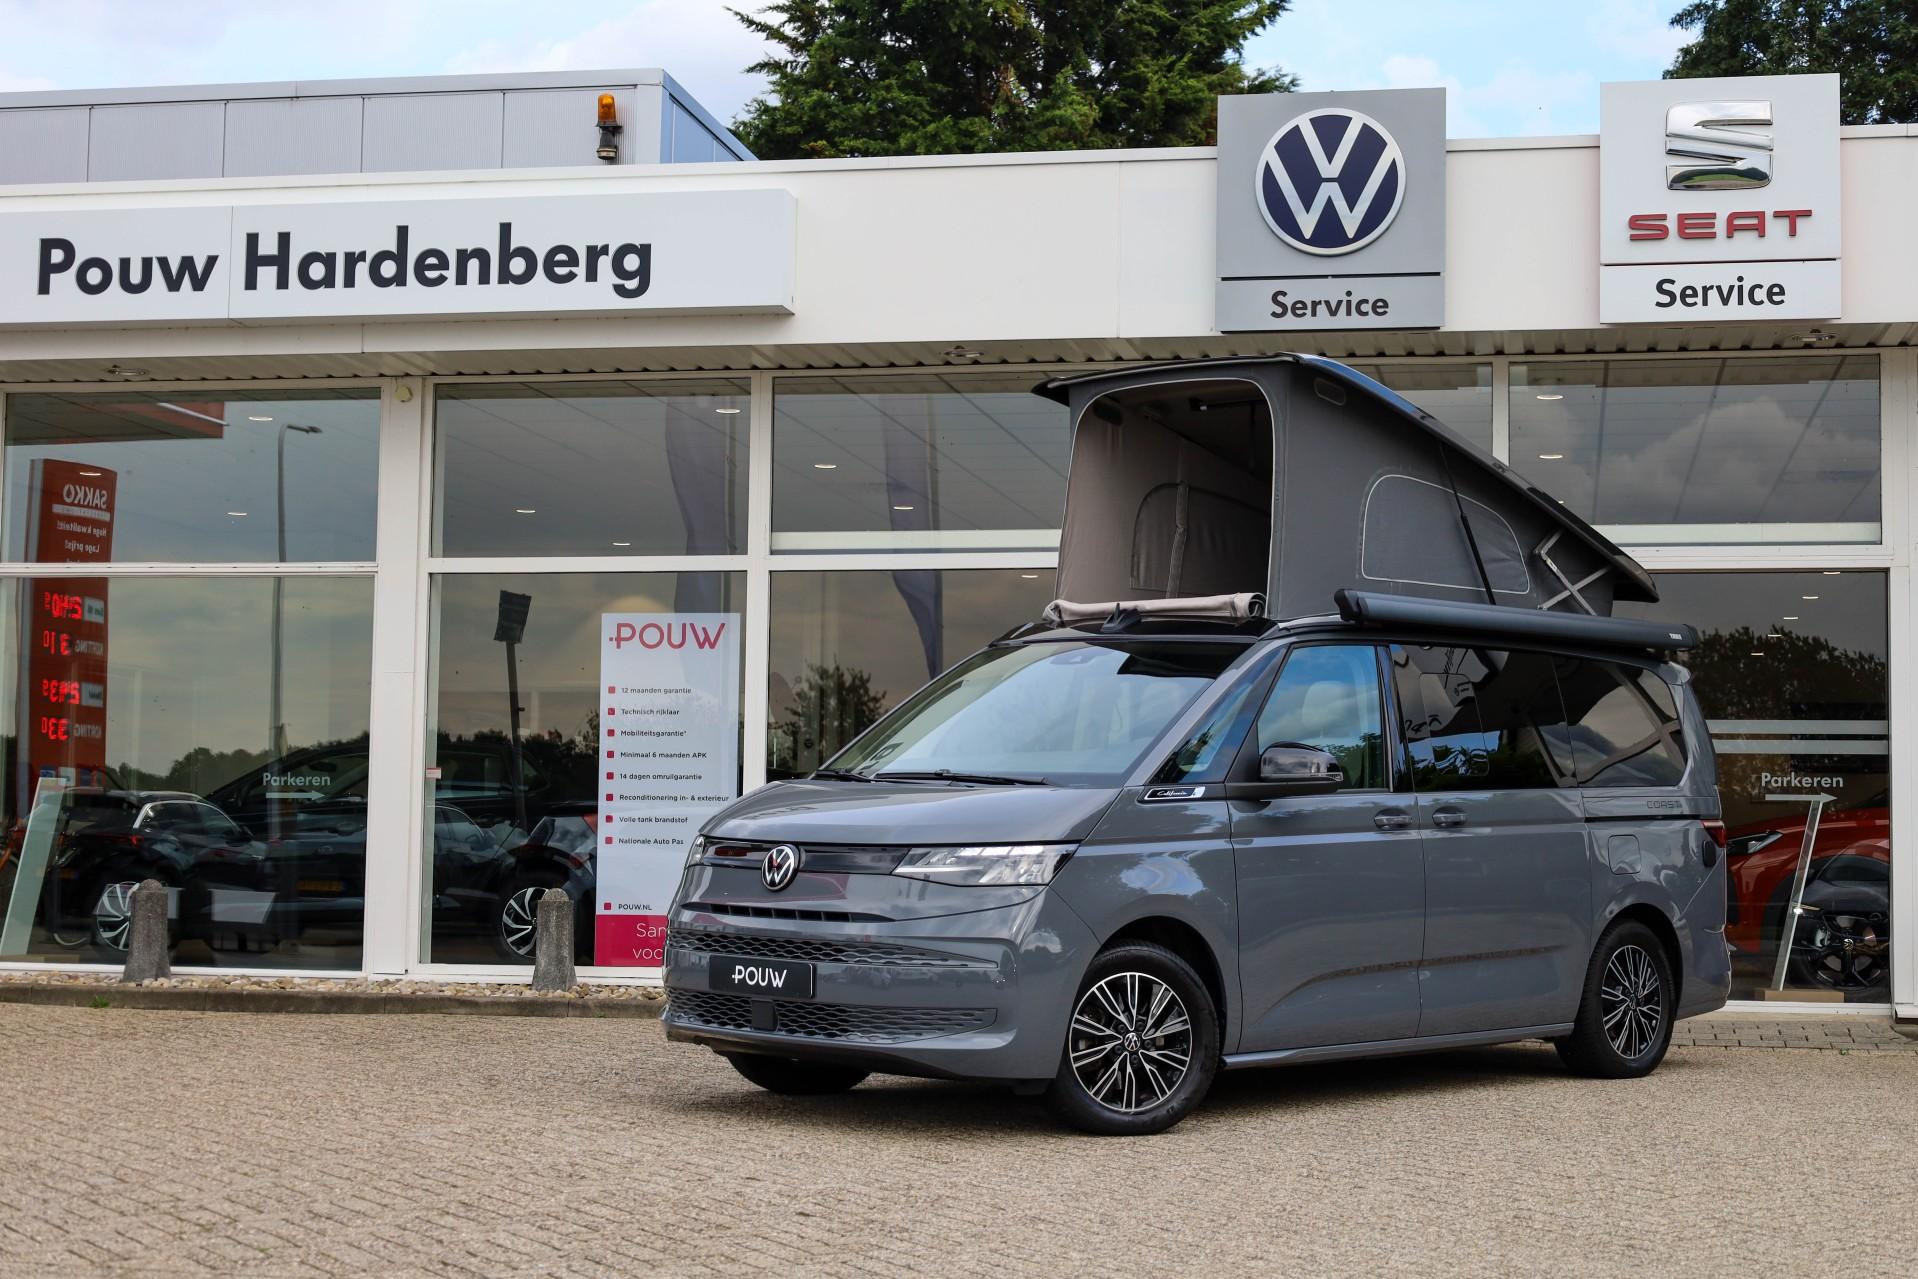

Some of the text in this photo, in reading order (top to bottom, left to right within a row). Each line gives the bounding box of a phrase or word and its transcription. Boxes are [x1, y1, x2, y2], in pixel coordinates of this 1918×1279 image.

[1628, 210, 1812, 241] SEAT
[37, 221, 652, 299] Pouw Hardenberg
[1655, 276, 1786, 310] Service
[1269, 290, 1389, 320] Service
[663, 687, 692, 695] garantie
[621, 708, 680, 717] Technisch rijklaar
[262, 771, 331, 786] Parkeren
[629, 773, 651, 782] dagen
[652, 773, 703, 782] omruilgarantie
[1761, 771, 1844, 788] Parkeren
[619, 794, 679, 802] Reconditionering
[654, 816, 688, 824] brandstof
[618, 903, 653, 911] POUW.NL
